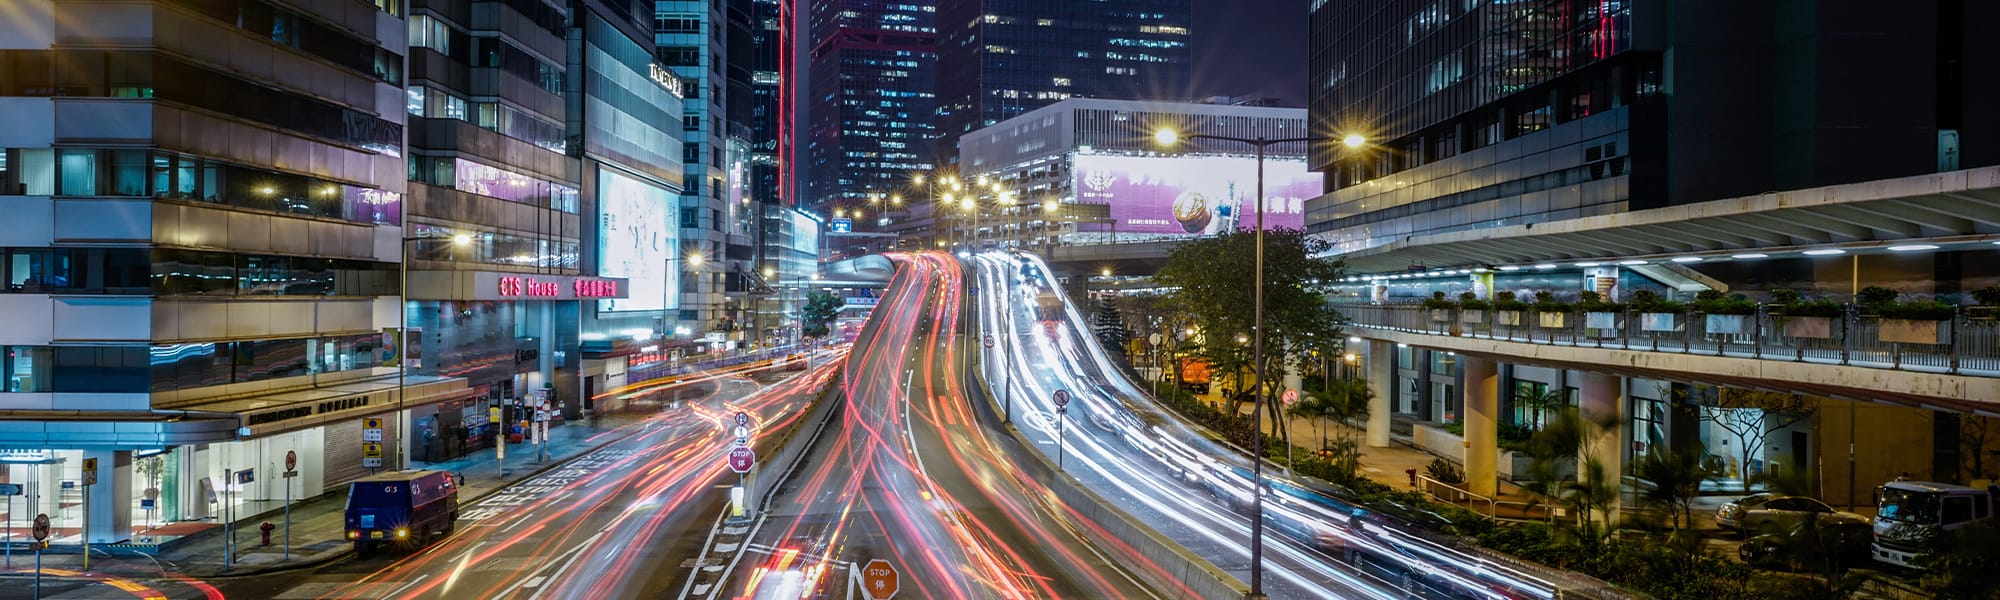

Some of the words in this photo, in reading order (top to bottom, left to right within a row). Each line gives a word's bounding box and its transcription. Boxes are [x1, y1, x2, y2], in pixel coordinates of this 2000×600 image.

[501, 277, 520, 296] CTS
[528, 278, 557, 296] House
[870, 569, 890, 577] STOP
